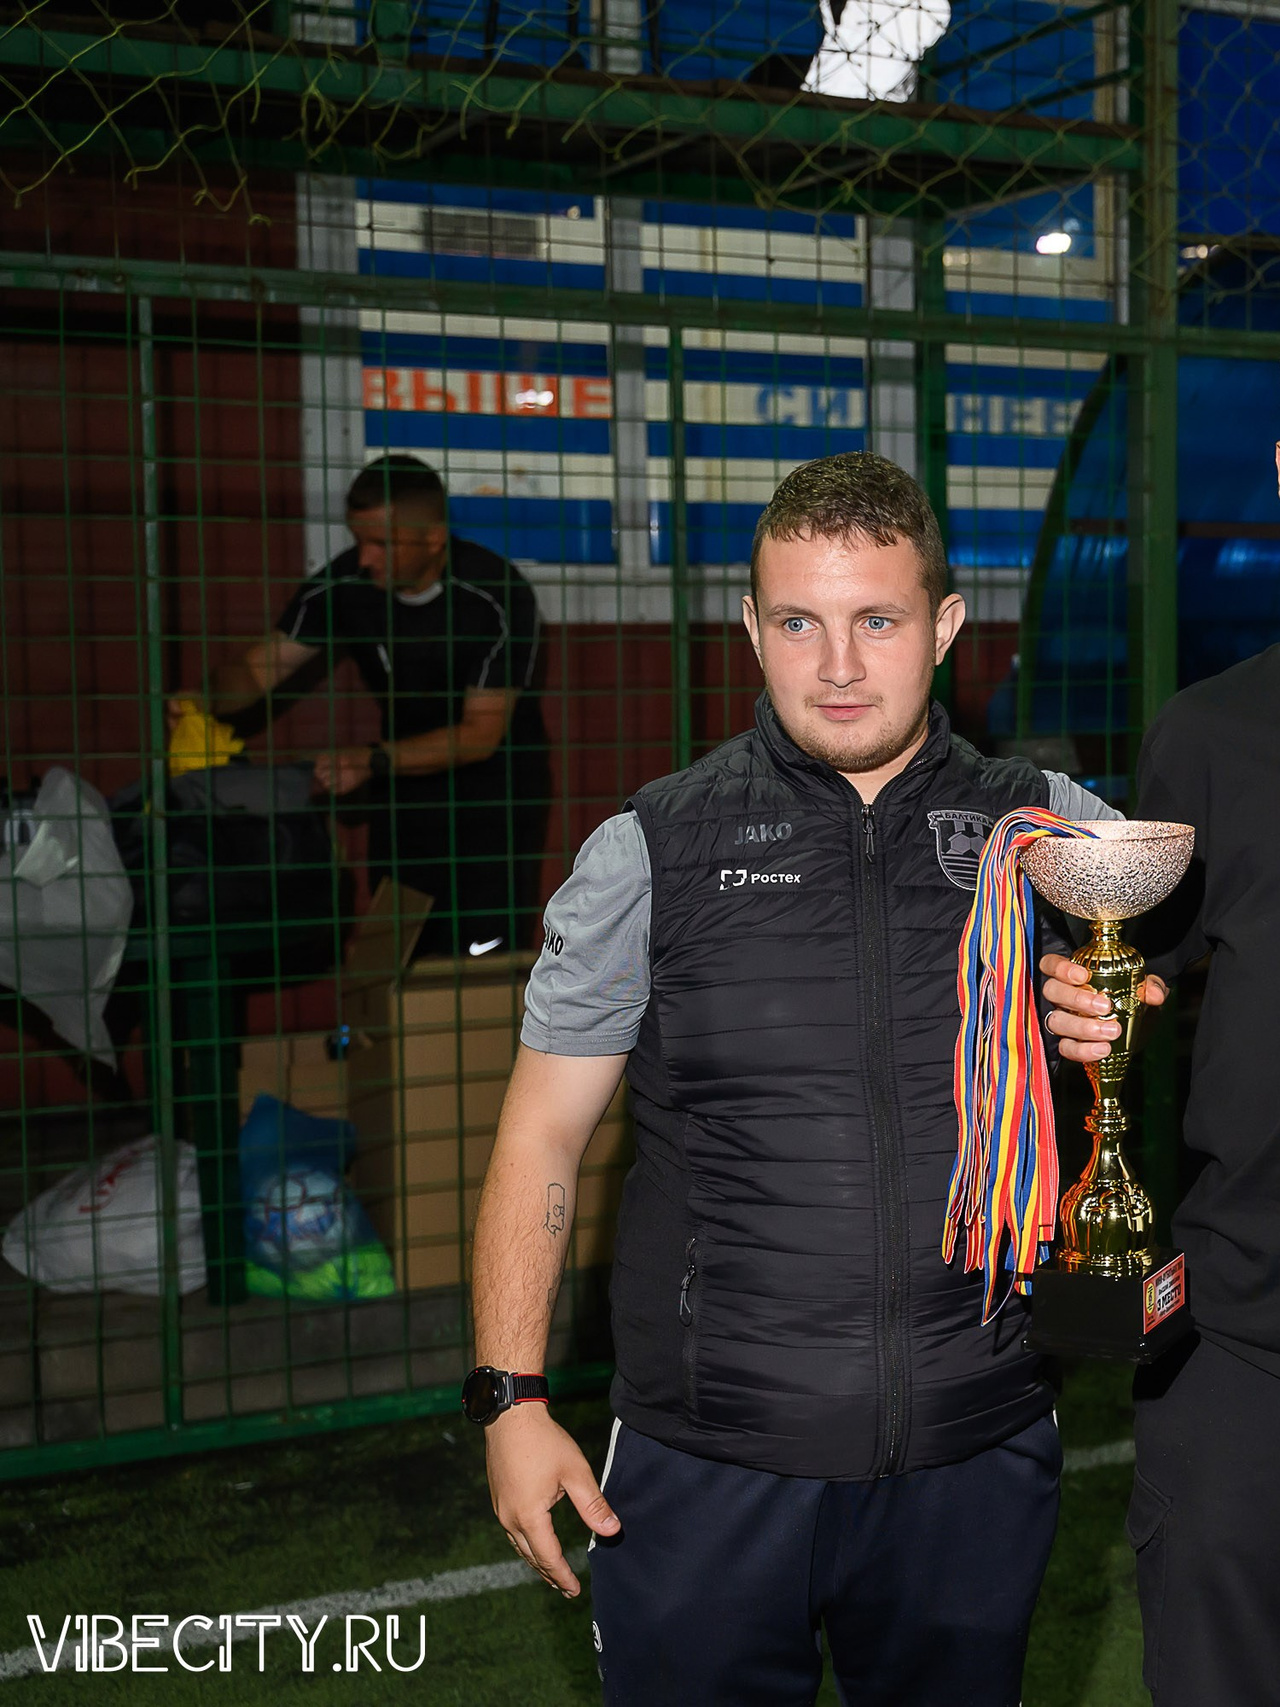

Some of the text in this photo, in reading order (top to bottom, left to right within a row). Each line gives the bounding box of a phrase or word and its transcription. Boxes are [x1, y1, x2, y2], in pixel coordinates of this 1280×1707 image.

[363, 366, 612, 419] ВЫШЕ
[734, 822, 793, 845] JAKO
[545, 923, 564, 956] AKO
